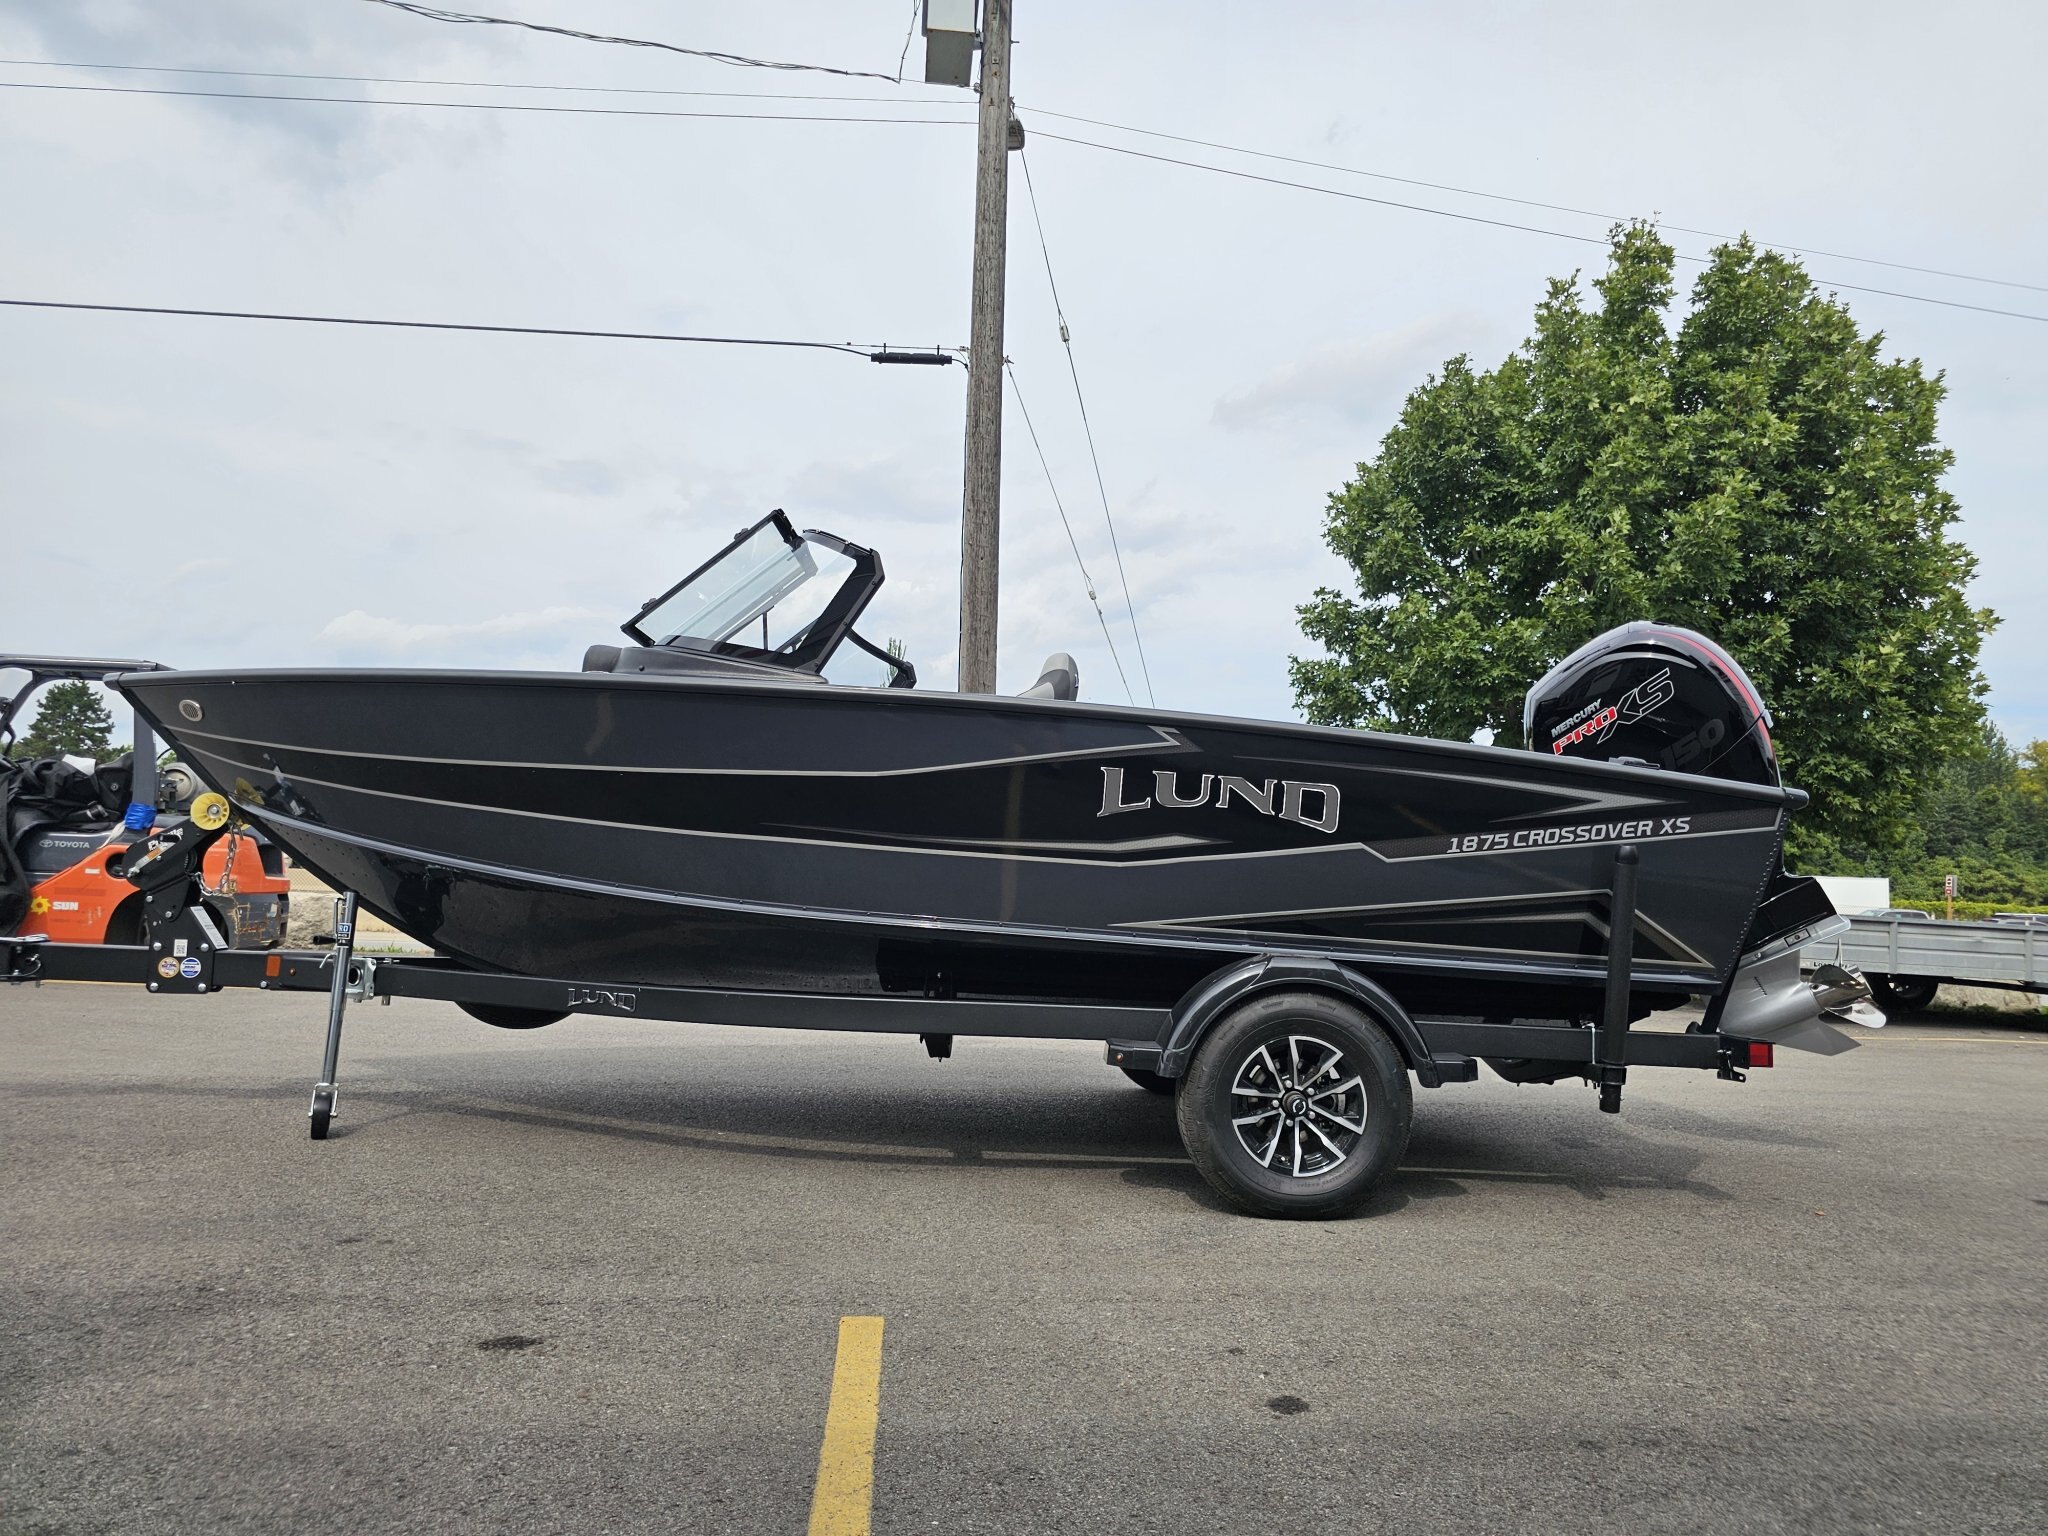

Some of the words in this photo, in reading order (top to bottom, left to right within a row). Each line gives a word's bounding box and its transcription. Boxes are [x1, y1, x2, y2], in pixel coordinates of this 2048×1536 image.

[1551, 698, 1601, 738] MERCURY
[1552, 706, 1618, 756] PRO
[1662, 718, 1725, 770] 150
[1097, 766, 1341, 834] LUND
[54, 840, 90, 849] TOYOTA
[1446, 833, 1509, 854] 1875
[1513, 820, 1653, 847] CROSSOVER
[1659, 817, 1692, 835] XS
[52, 901, 79, 911] SUN
[567, 988, 636, 1012] LUND
